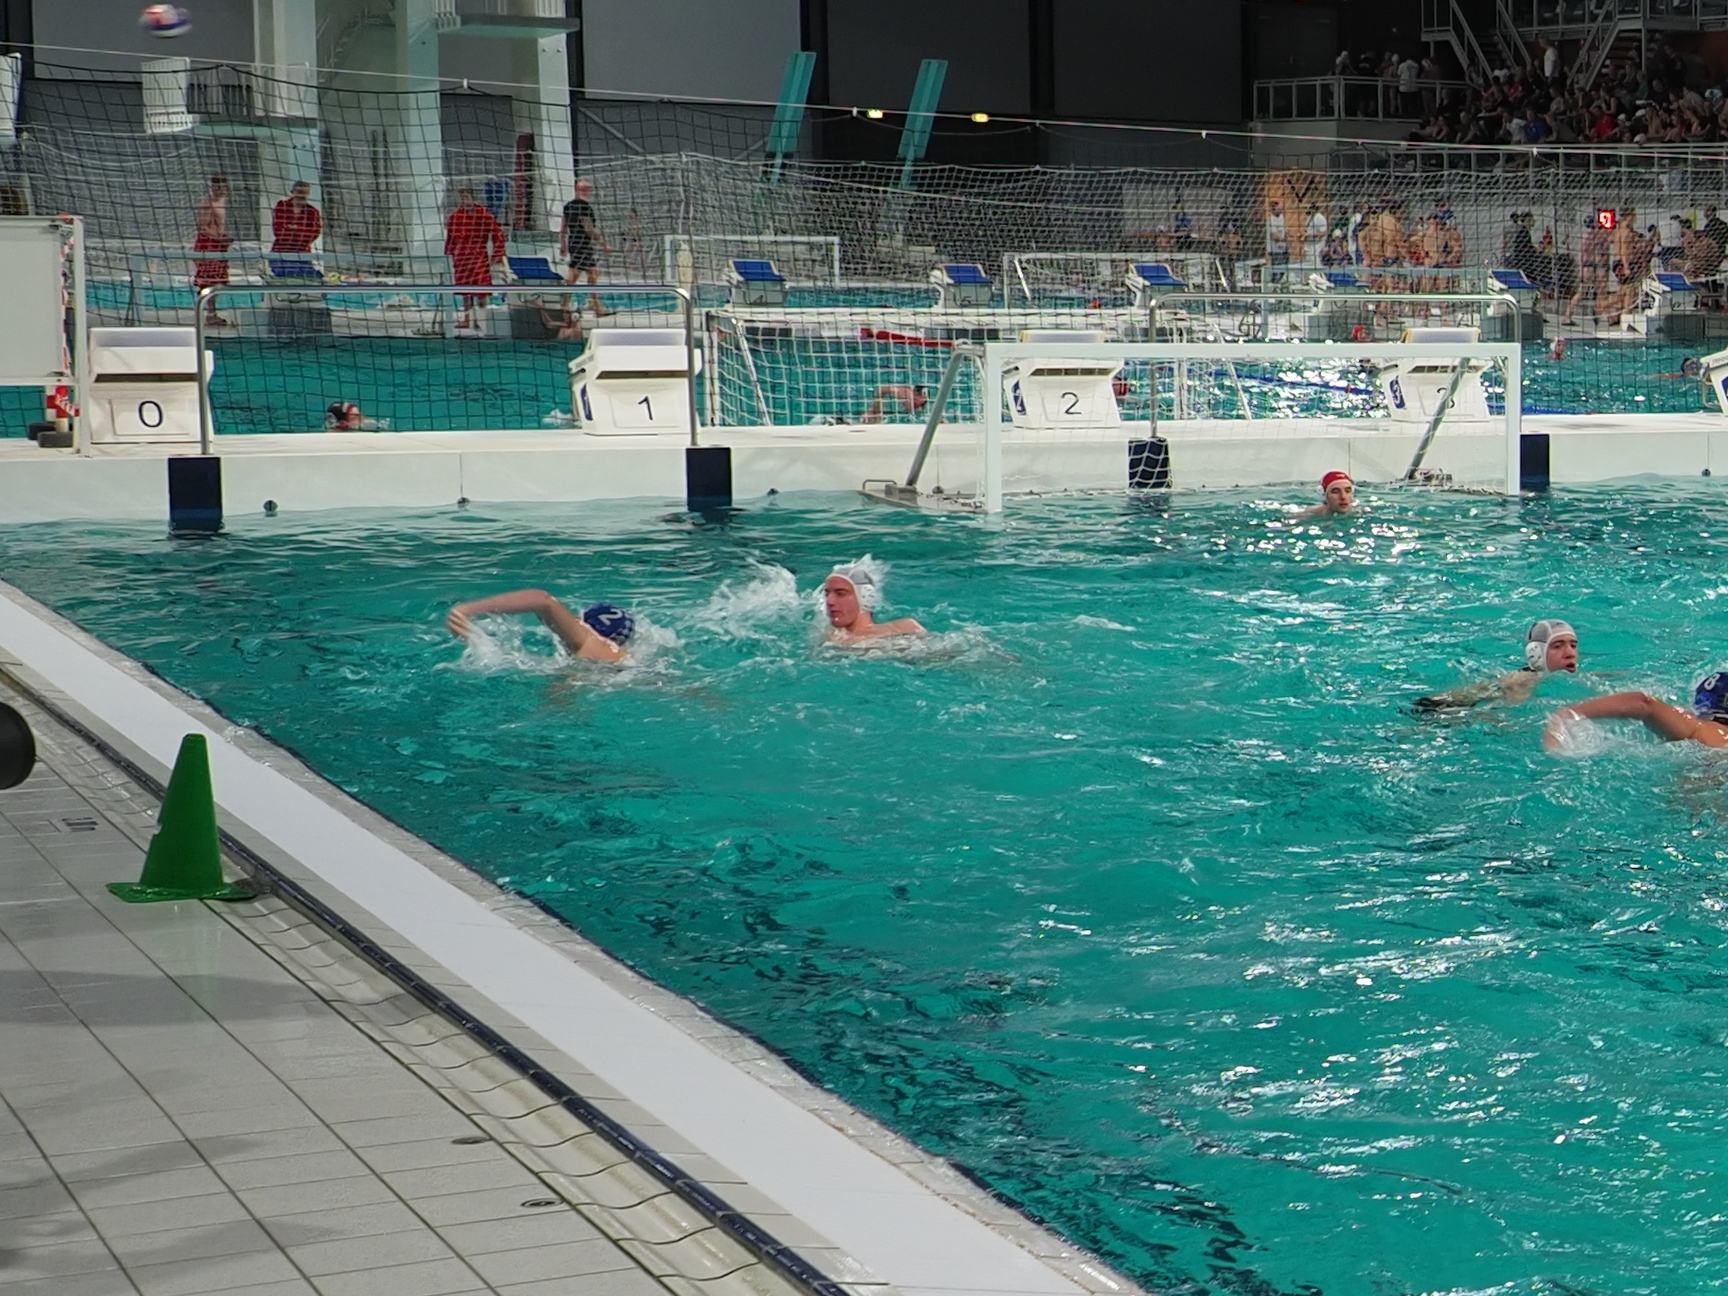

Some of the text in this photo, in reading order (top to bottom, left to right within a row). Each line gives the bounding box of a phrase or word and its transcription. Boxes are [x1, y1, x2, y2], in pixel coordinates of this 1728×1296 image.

[137, 400, 164, 428] 0
[637, 395, 653, 422] 1
[1060, 391, 1083, 415] 2
[597, 608, 624, 627] 2
[1704, 673, 1721, 691] 8
